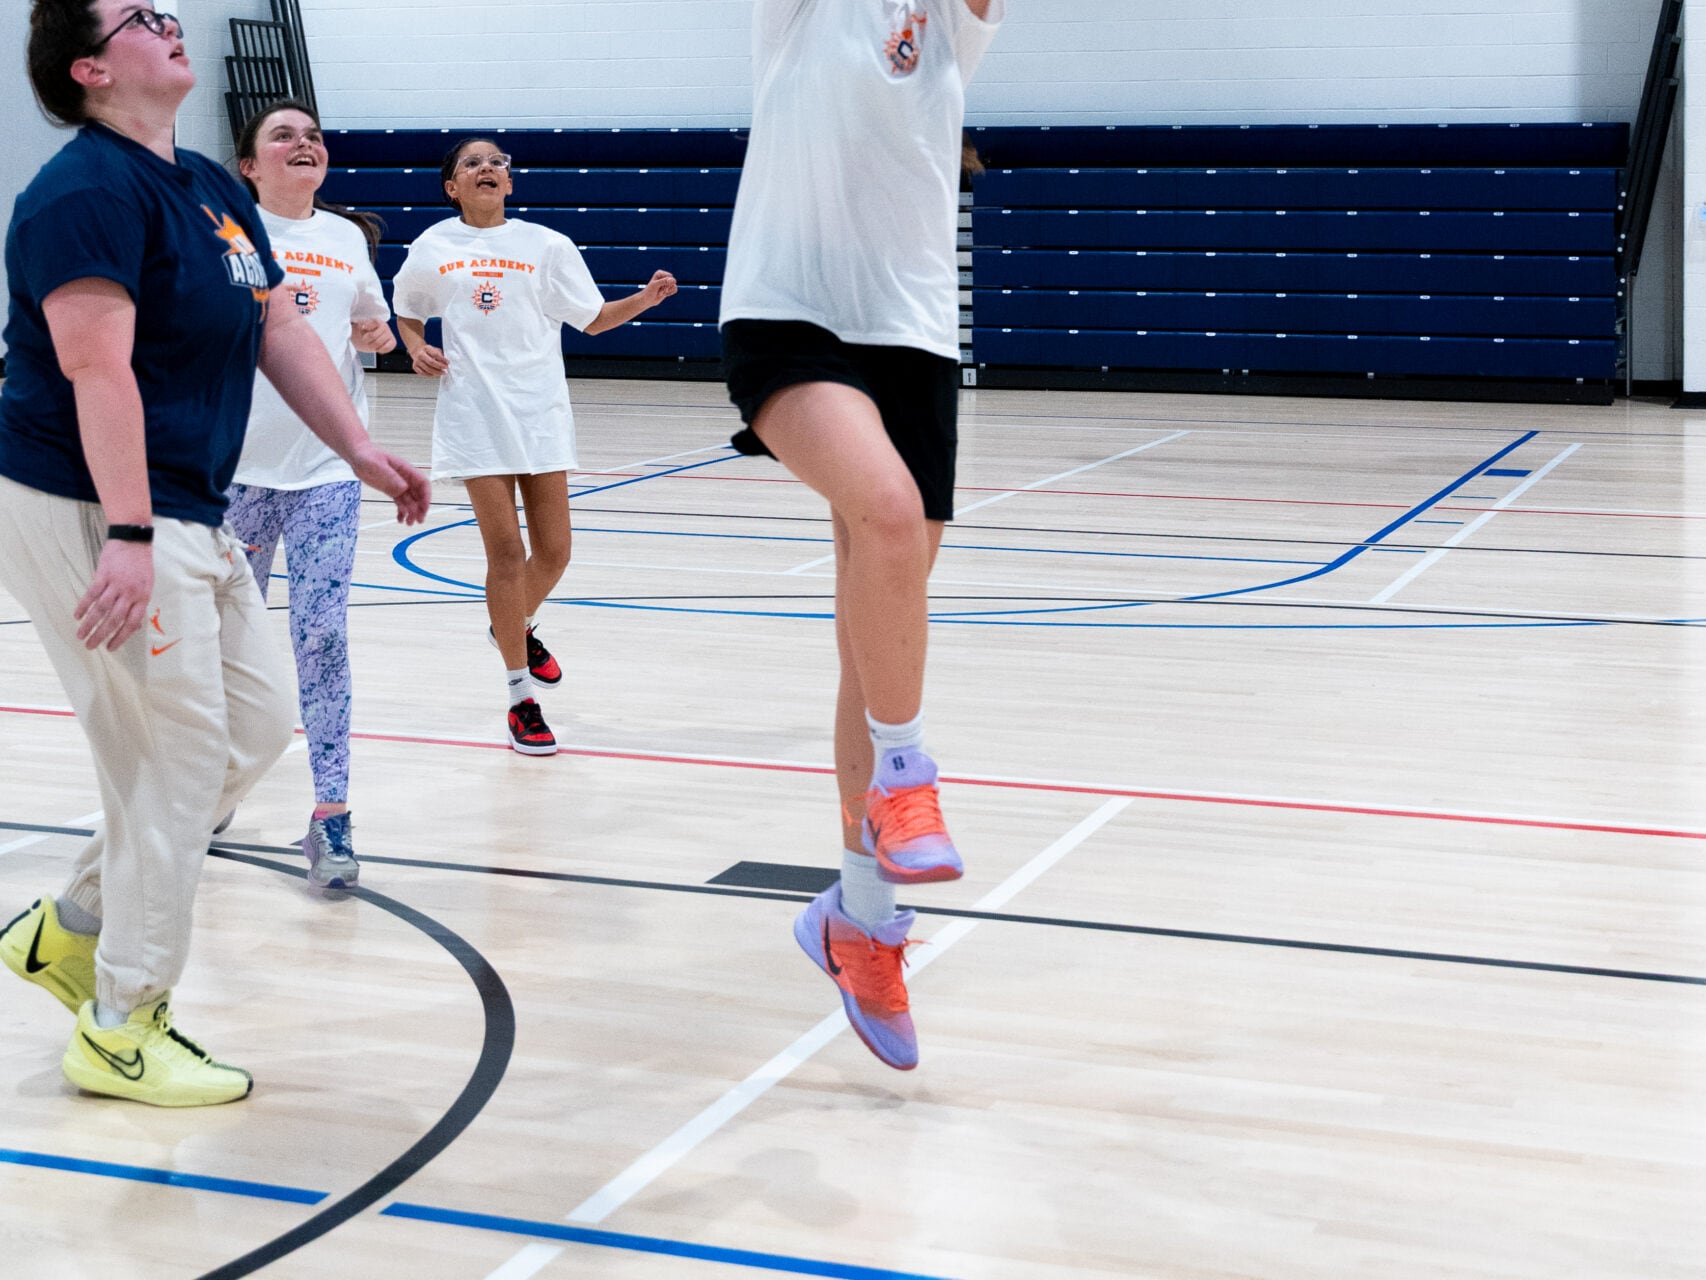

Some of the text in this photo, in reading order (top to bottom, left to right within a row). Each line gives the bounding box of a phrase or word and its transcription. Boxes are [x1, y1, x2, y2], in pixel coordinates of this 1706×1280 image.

[285, 251, 354, 274] ACADEMY
[439, 259, 535, 275] SUN ACADEMY
